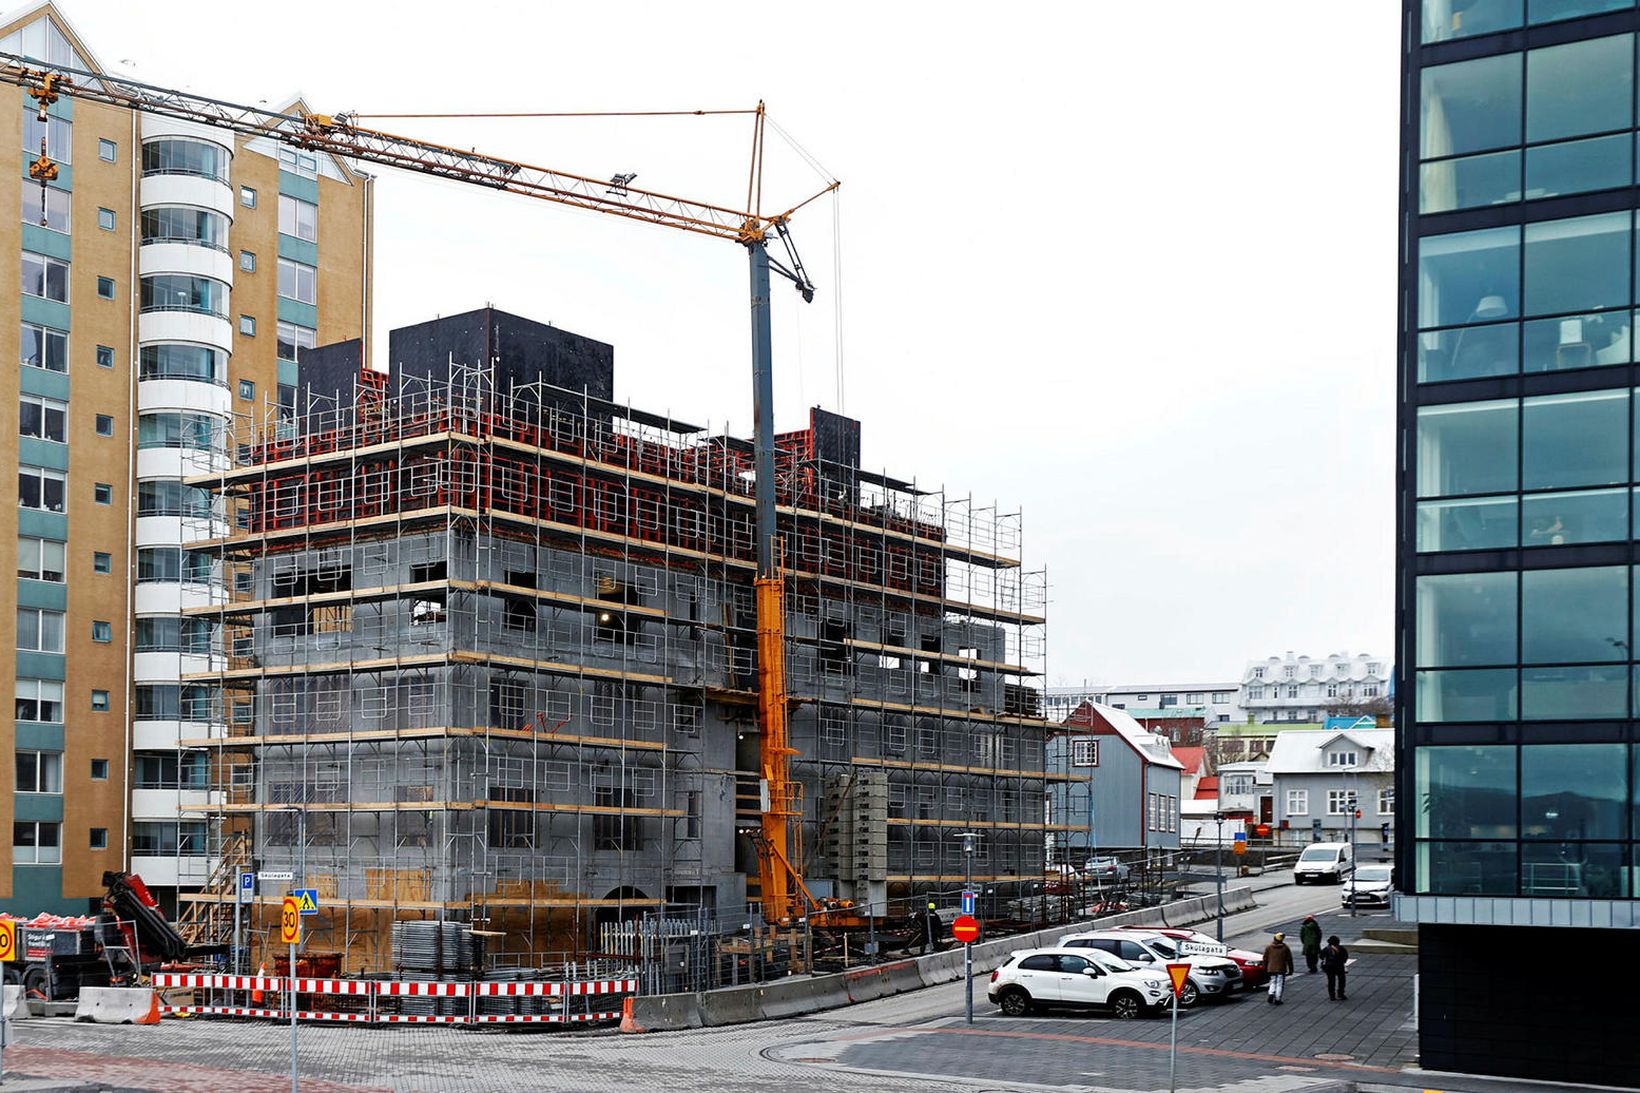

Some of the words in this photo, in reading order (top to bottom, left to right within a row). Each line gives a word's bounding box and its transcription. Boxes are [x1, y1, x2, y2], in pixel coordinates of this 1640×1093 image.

[244, 876, 251, 886] P
[283, 911, 295, 928] 30
[0, 933, 8, 948] 0
